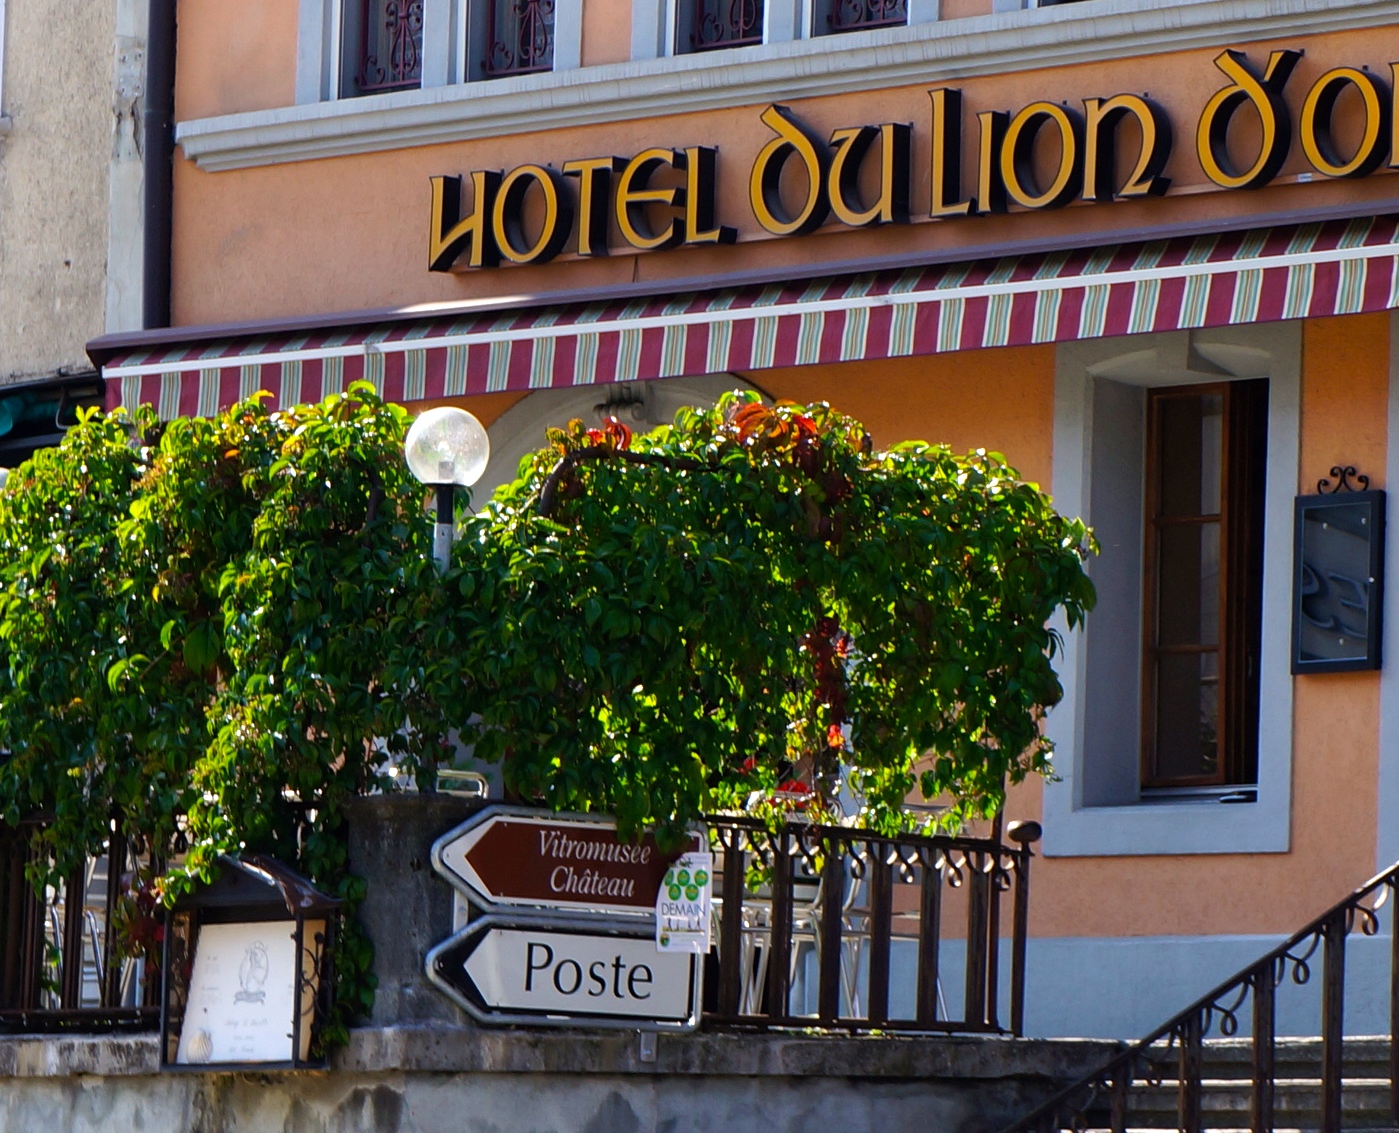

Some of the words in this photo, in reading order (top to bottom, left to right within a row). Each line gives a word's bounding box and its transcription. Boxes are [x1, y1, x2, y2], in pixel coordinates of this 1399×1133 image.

[429, 144, 738, 272] HOTEL
[550, 866, 635, 897] Château
[661, 902, 706, 916] DEMAIN
[524, 941, 654, 1000] Poste
